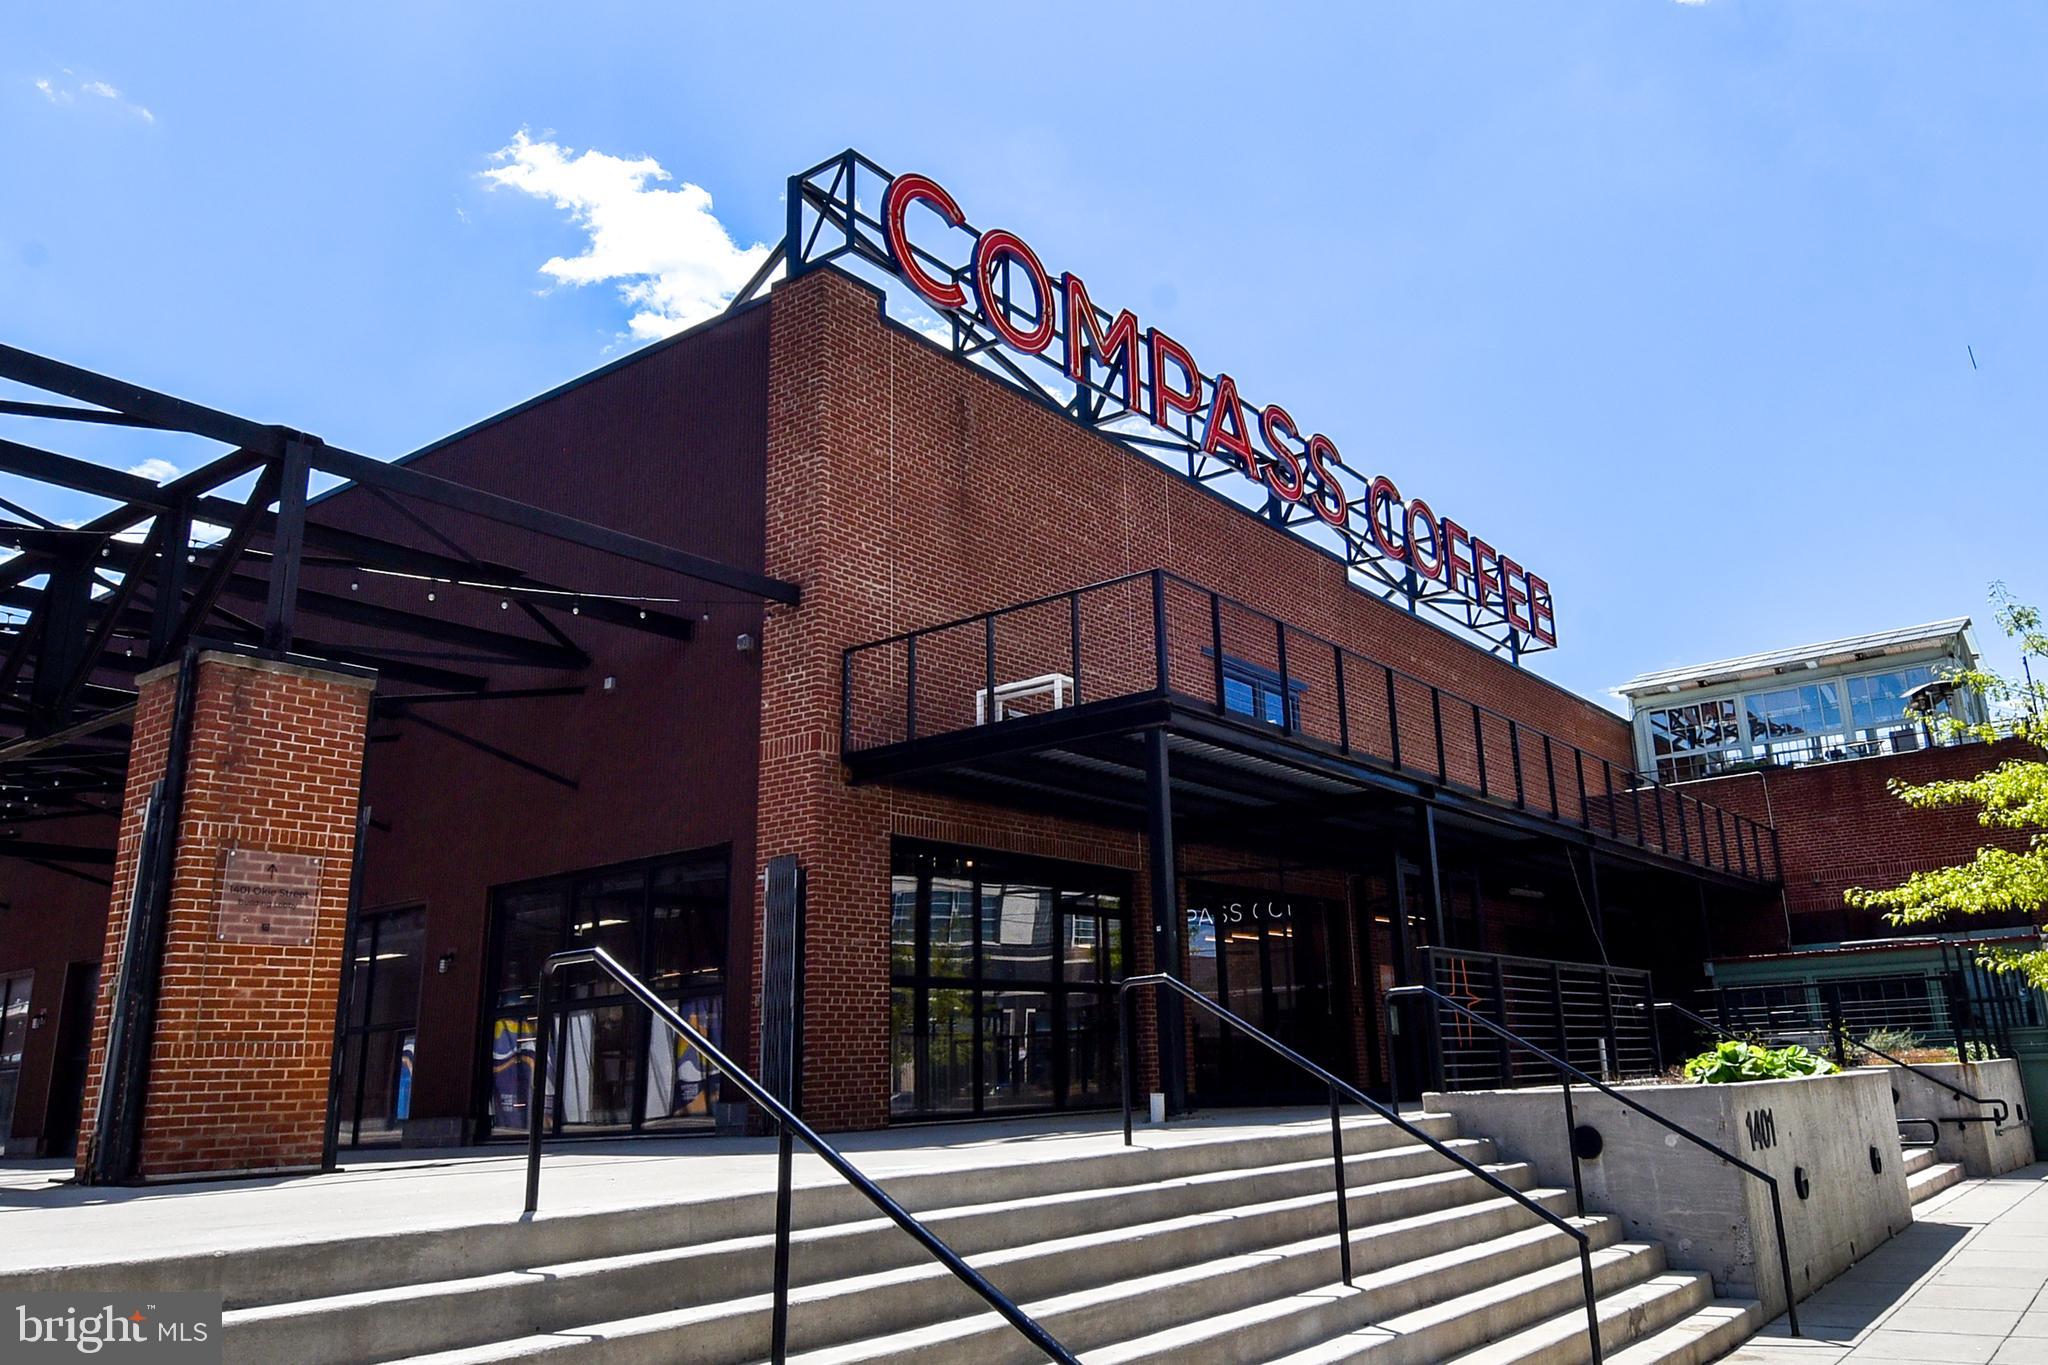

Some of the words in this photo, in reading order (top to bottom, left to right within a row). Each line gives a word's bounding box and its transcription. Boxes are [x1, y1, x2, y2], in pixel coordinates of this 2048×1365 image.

[884, 173, 1348, 528] COMPASS
[1365, 475, 1557, 648] COFFEE
[280, 888, 309, 899] Street
[1745, 1107, 1778, 1152] 1401
